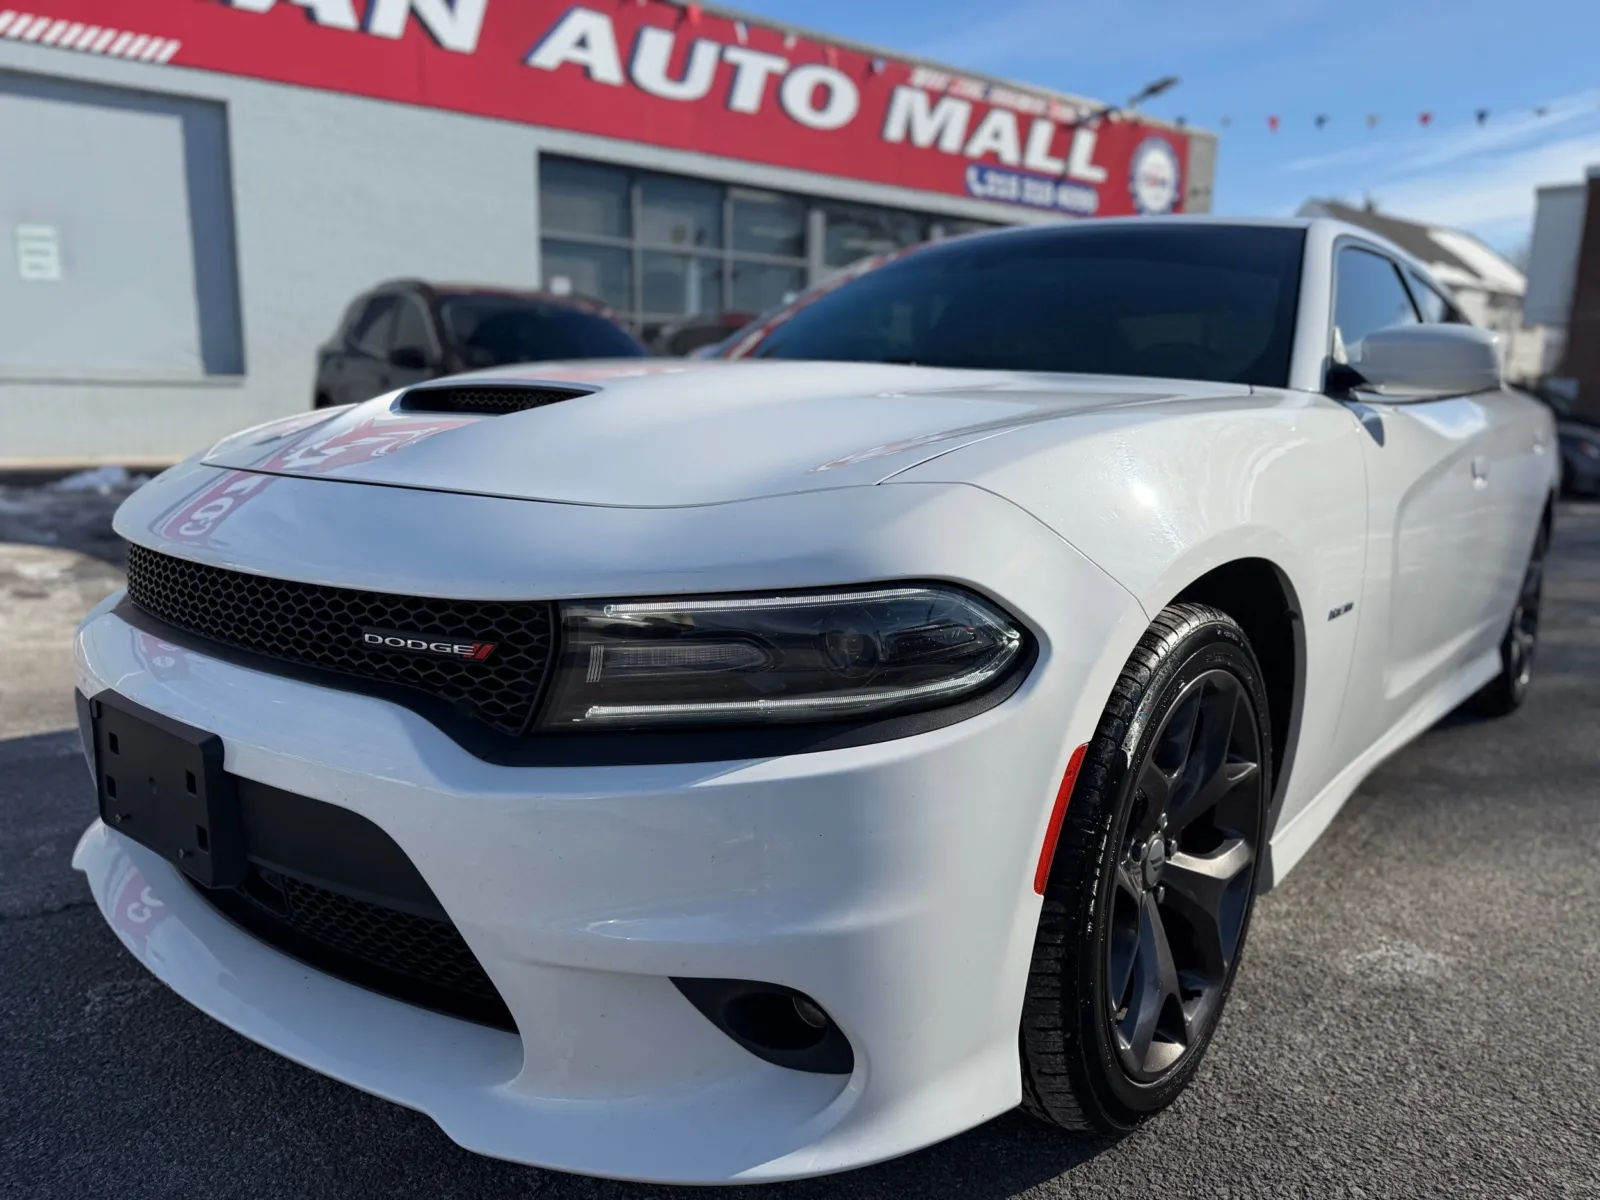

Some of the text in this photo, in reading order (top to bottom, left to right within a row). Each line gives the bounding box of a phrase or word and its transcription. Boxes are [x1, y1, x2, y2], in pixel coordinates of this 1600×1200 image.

[524, 7, 859, 130] AUTO
[883, 86, 1108, 182] MALL
[364, 633, 475, 656] DODGE
